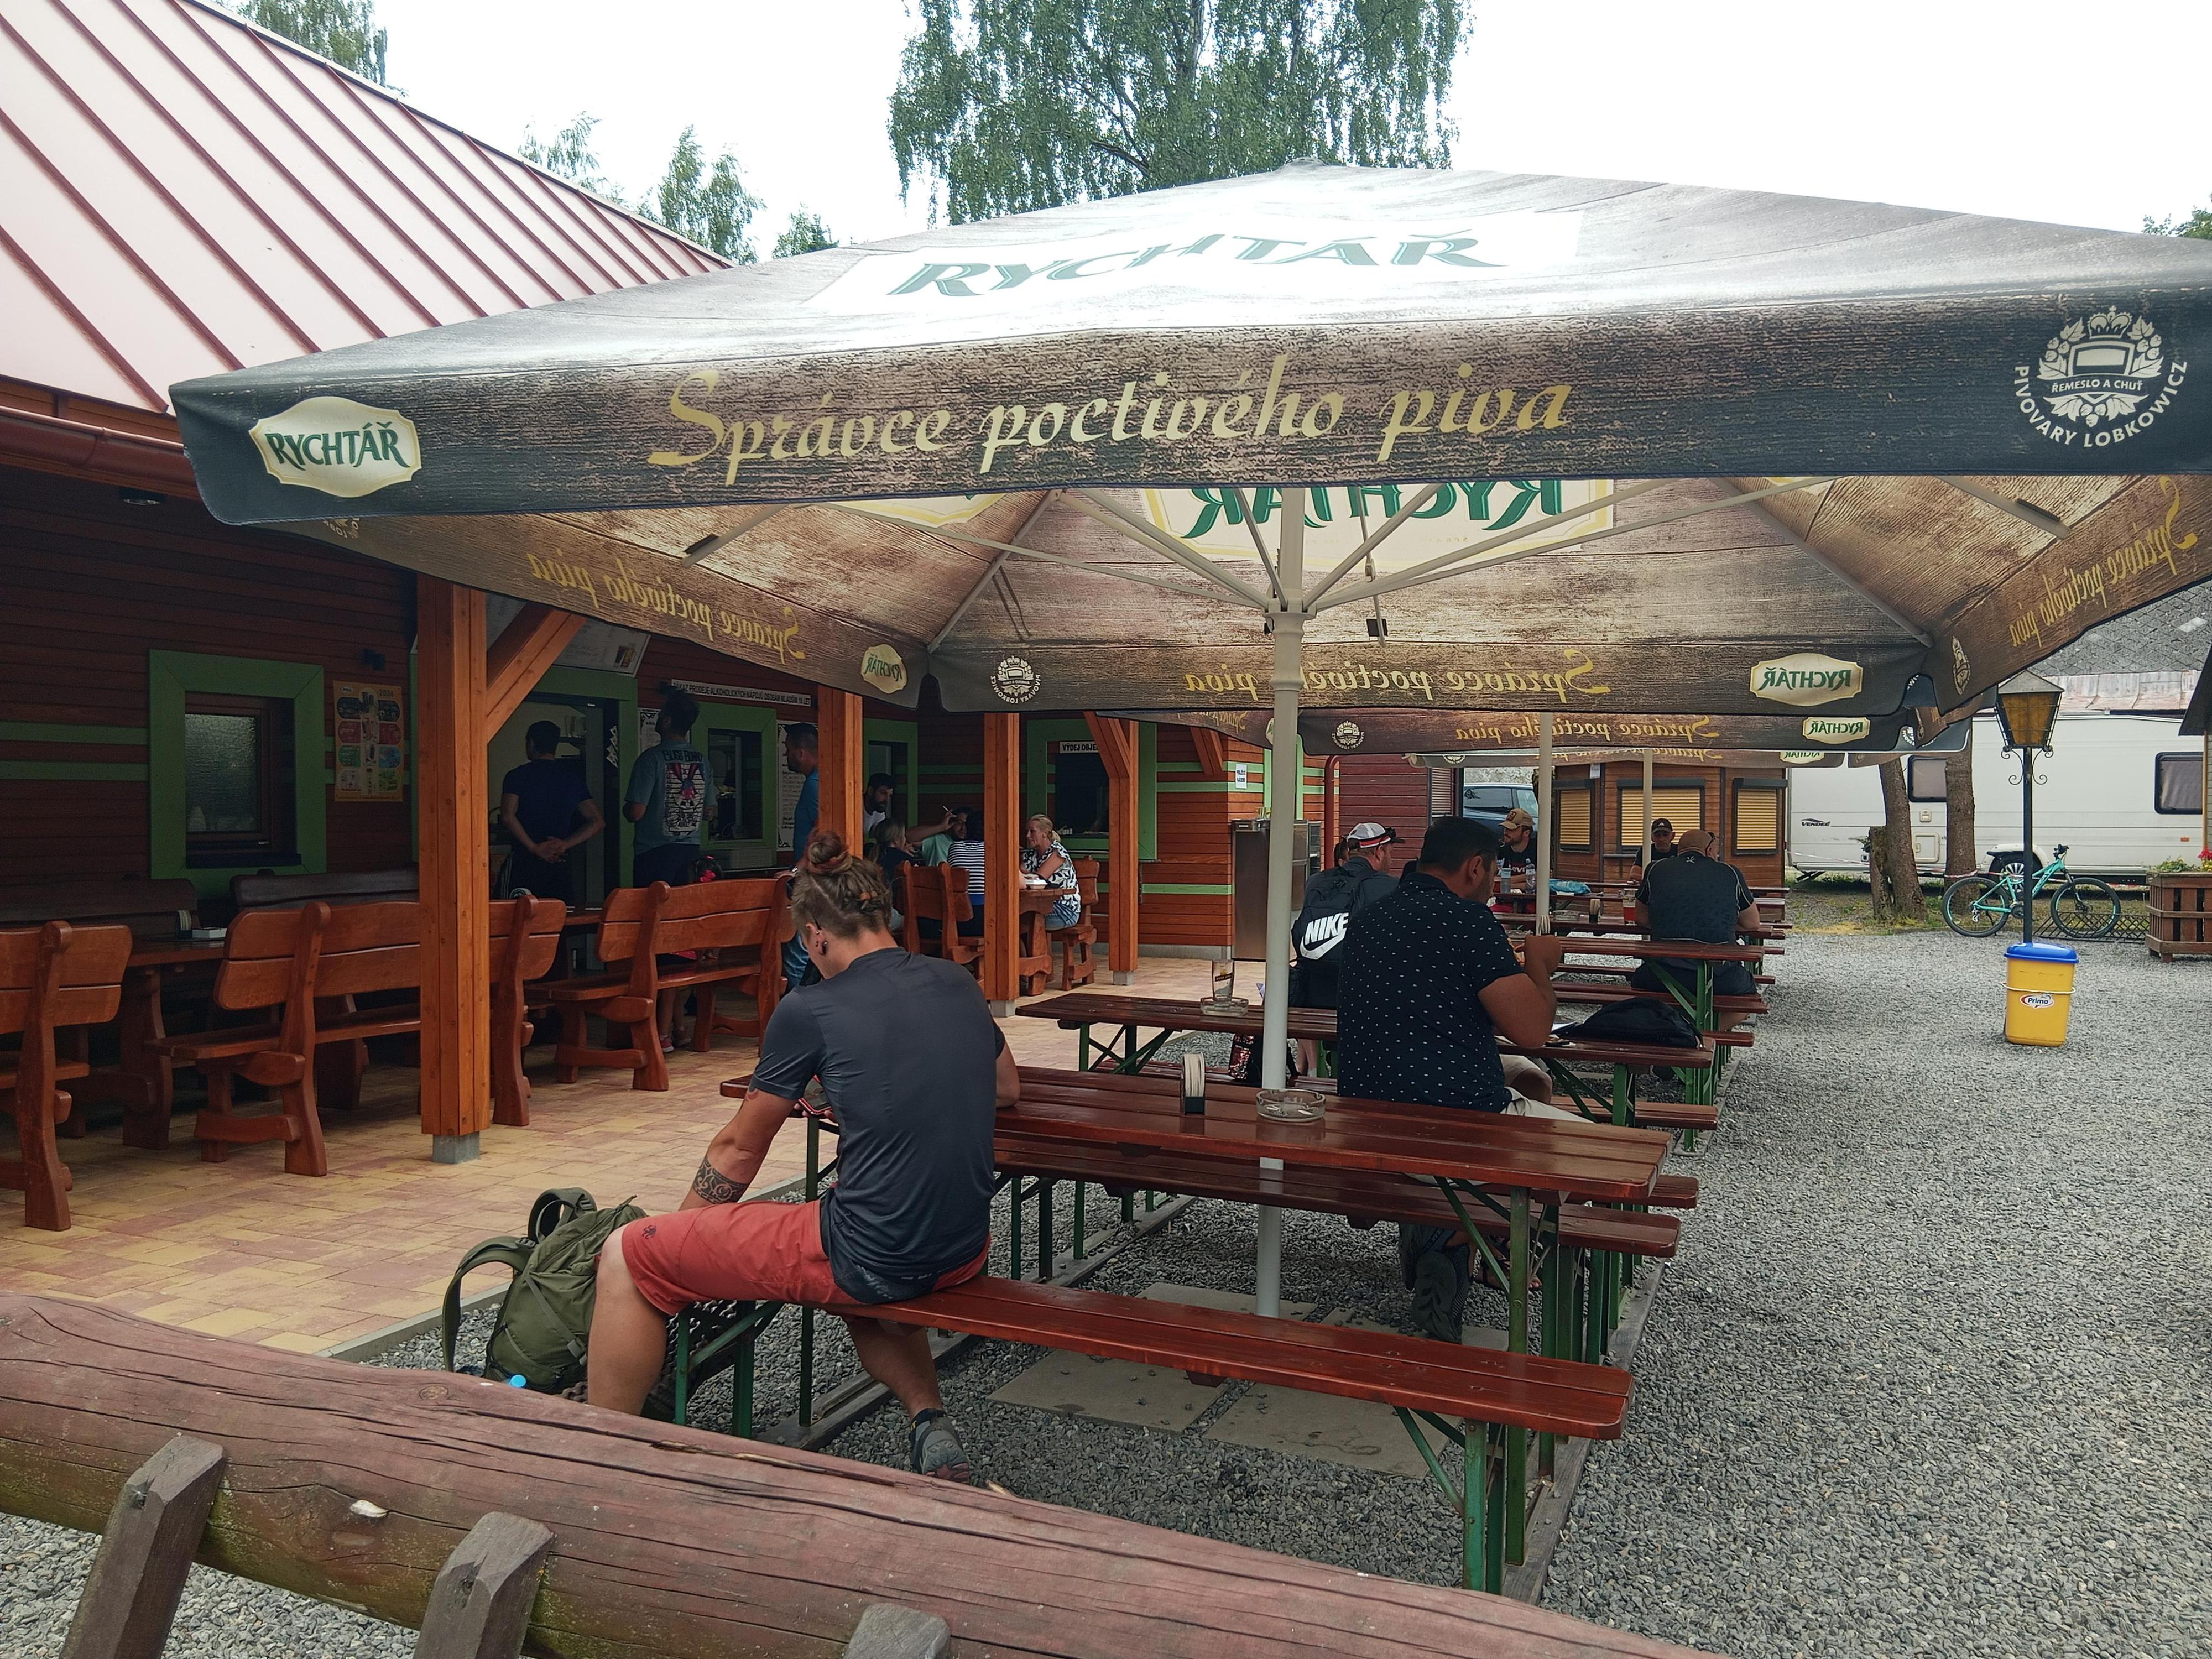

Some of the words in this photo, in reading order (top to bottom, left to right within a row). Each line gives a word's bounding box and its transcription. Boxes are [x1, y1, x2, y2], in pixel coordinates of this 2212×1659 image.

[886, 229, 1510, 298] RYCHTÁŘ
[2014, 366, 2077, 445] PIVOVARY
[2084, 361, 2187, 447] LOBKOWICZ
[2052, 379, 2100, 393] ŘEMESLO
[2103, 379, 2111, 388] A
[2114, 379, 2143, 391] CHUŤ
[648, 369, 951, 486] Správce
[978, 354, 1347, 474] poctivého
[1376, 363, 1575, 462] piva
[264, 421, 411, 471] RYCHTÁŘ
[1062, 743, 1080, 751] VÝDEJ
[1305, 912, 1349, 946] NIKE
